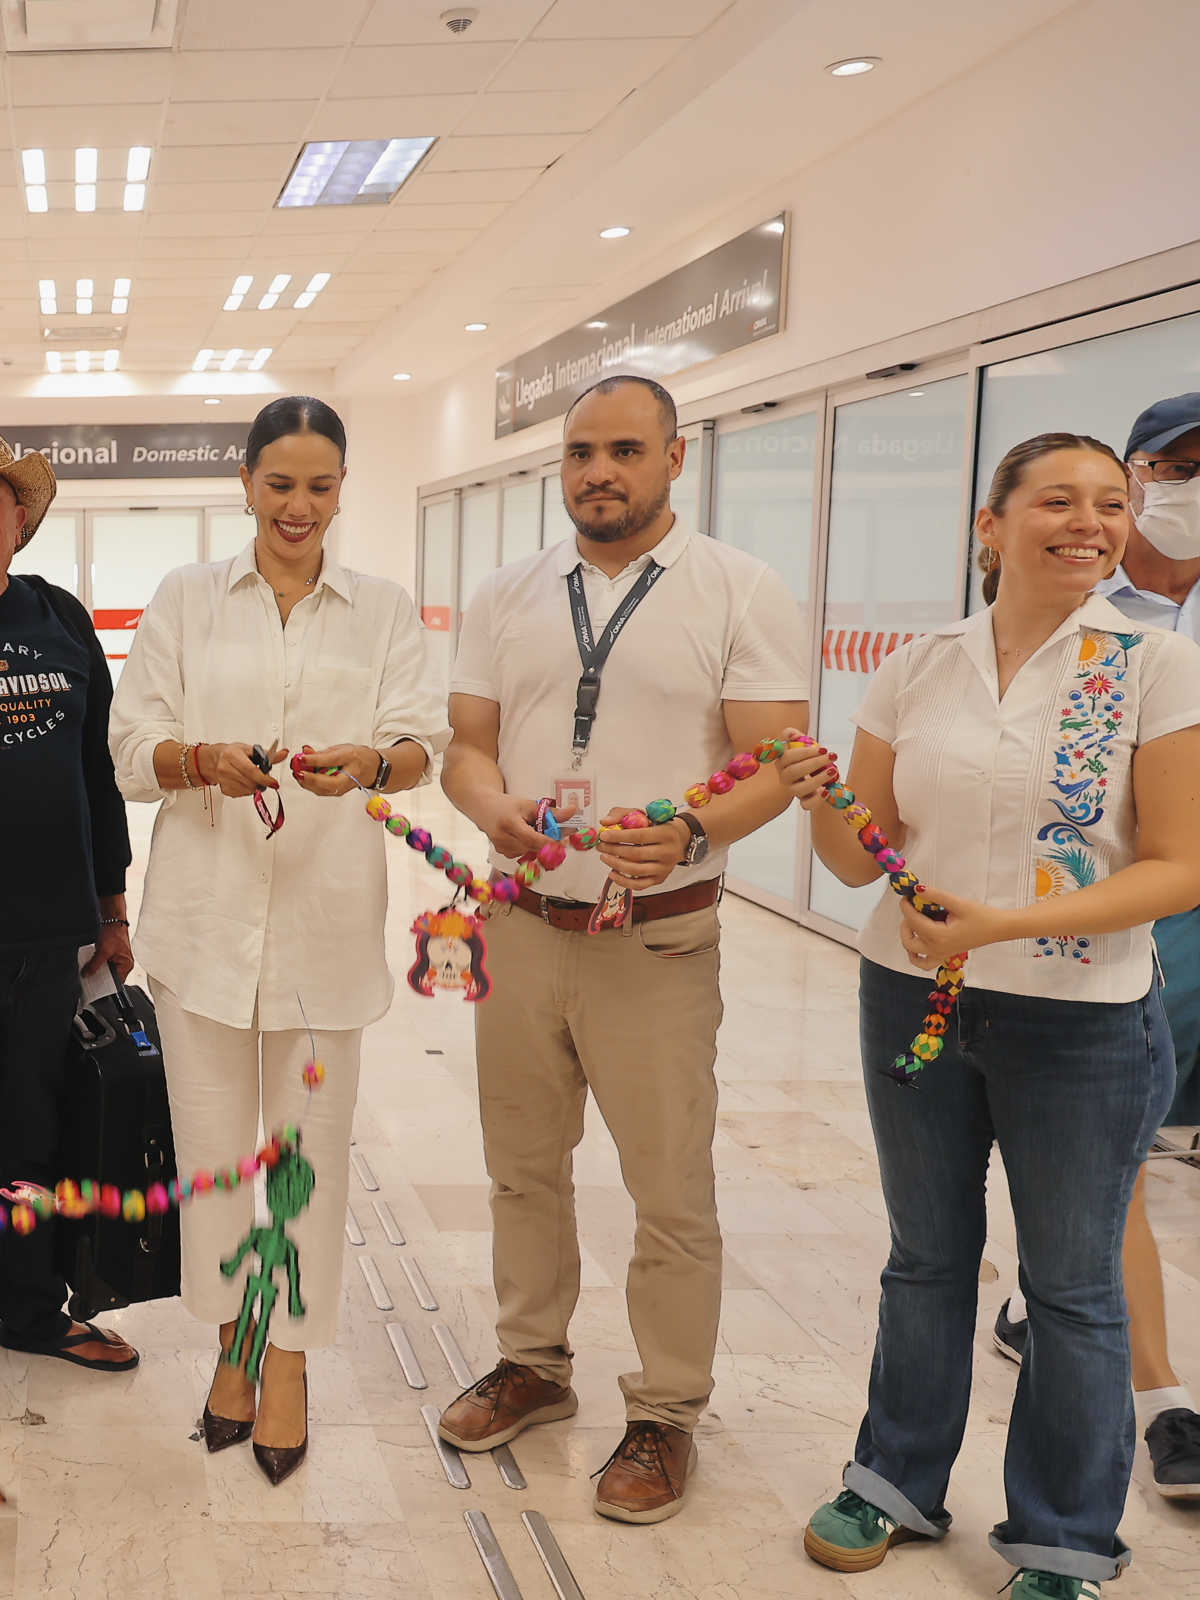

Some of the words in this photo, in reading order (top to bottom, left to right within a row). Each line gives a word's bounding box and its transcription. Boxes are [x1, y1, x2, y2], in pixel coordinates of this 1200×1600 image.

[515, 366, 553, 411] Llegada
[555, 323, 636, 388] Internacional
[644, 293, 718, 353] International
[719, 269, 768, 319] Arrival
[133, 444, 220, 462] Domestic
[223, 444, 247, 460] Ar
[581, 625, 590, 643] OMA
[612, 617, 626, 634] OMA
[0, 698, 52, 713] QUALITY
[6, 713, 36, 725] 1903
